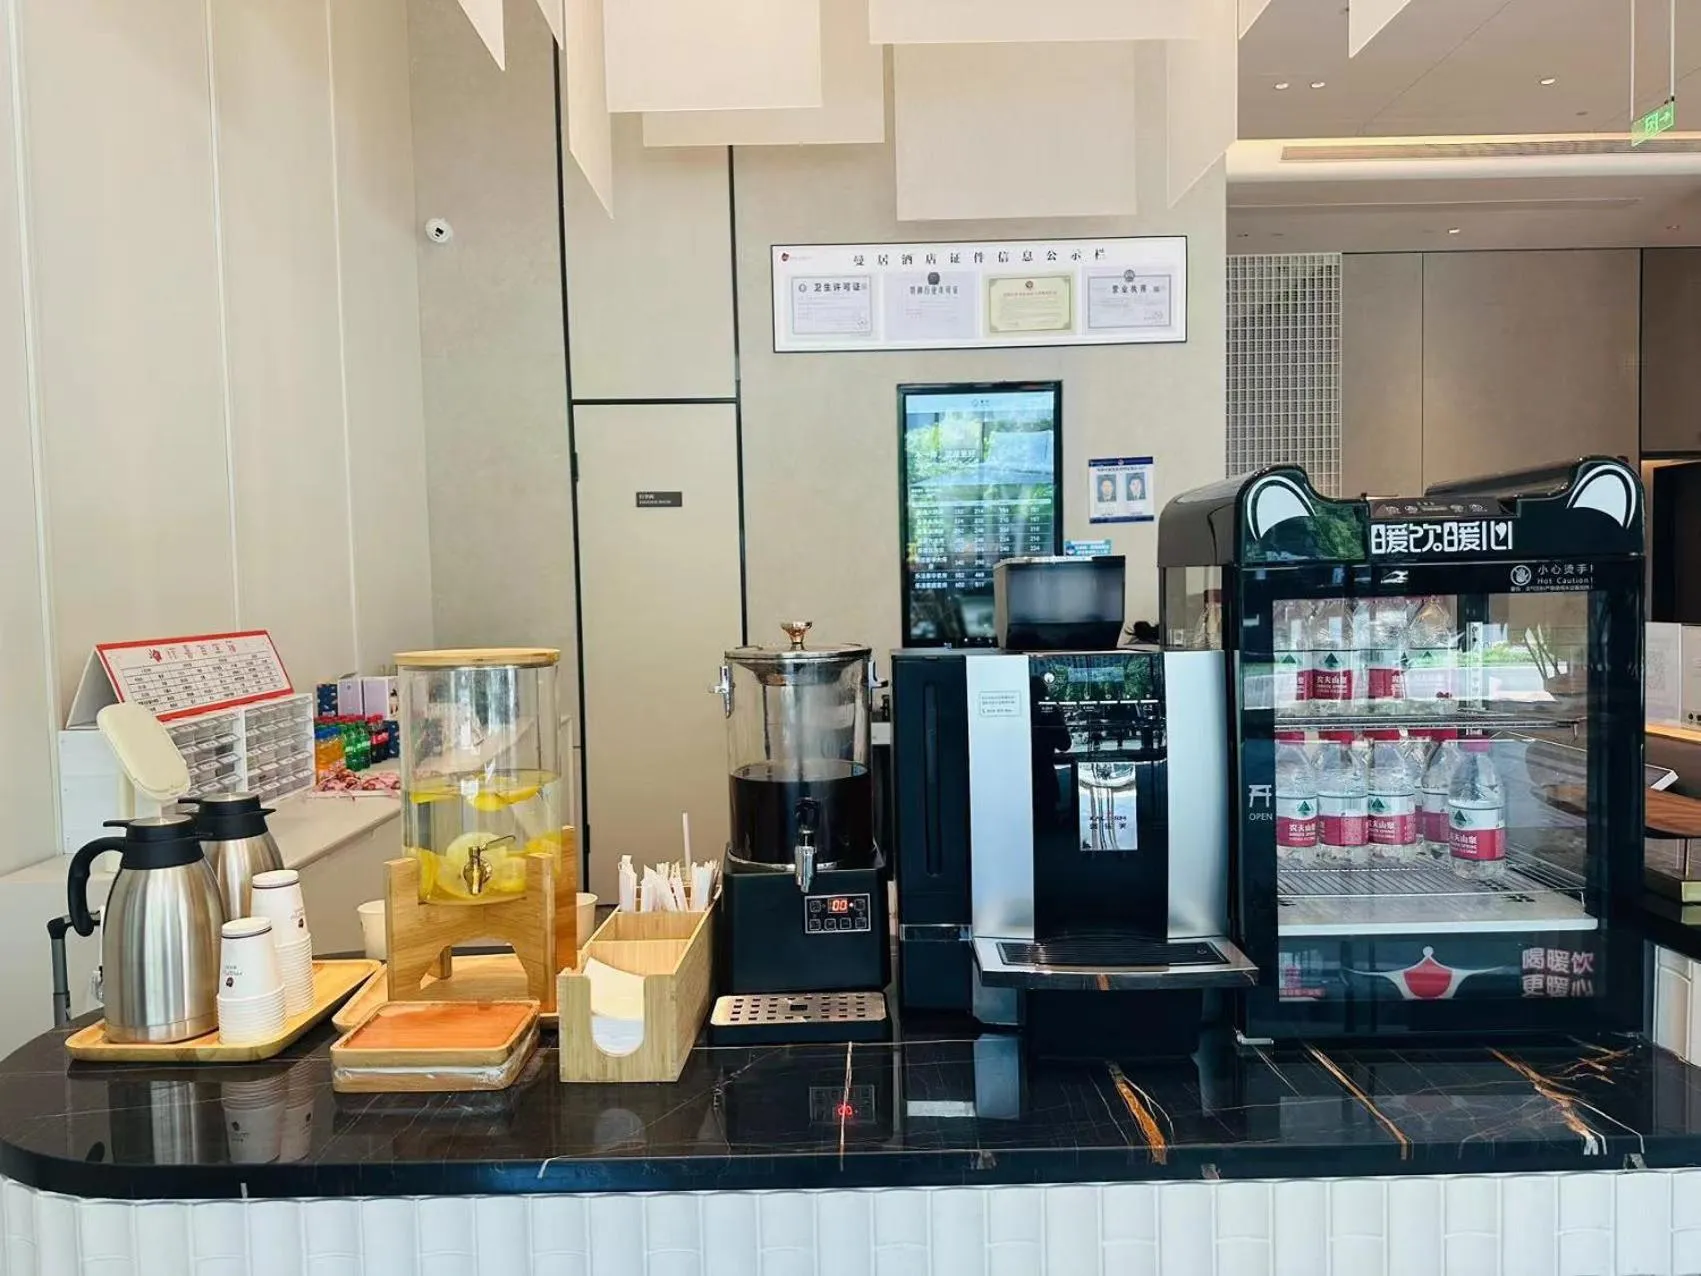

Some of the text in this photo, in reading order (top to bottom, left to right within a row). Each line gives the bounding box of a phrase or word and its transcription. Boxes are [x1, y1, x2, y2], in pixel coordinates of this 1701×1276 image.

[853, 249, 1106, 266] 曼居酒店证件信息公示栏
[814, 282, 861, 292] 卫生许可证
[1370, 520, 1513, 554] 暖饮暖心
[1249, 812, 1273, 821] OPEN
[1522, 947, 1594, 974] 喝暖饮
[1522, 974, 1594, 998] 更暖心
